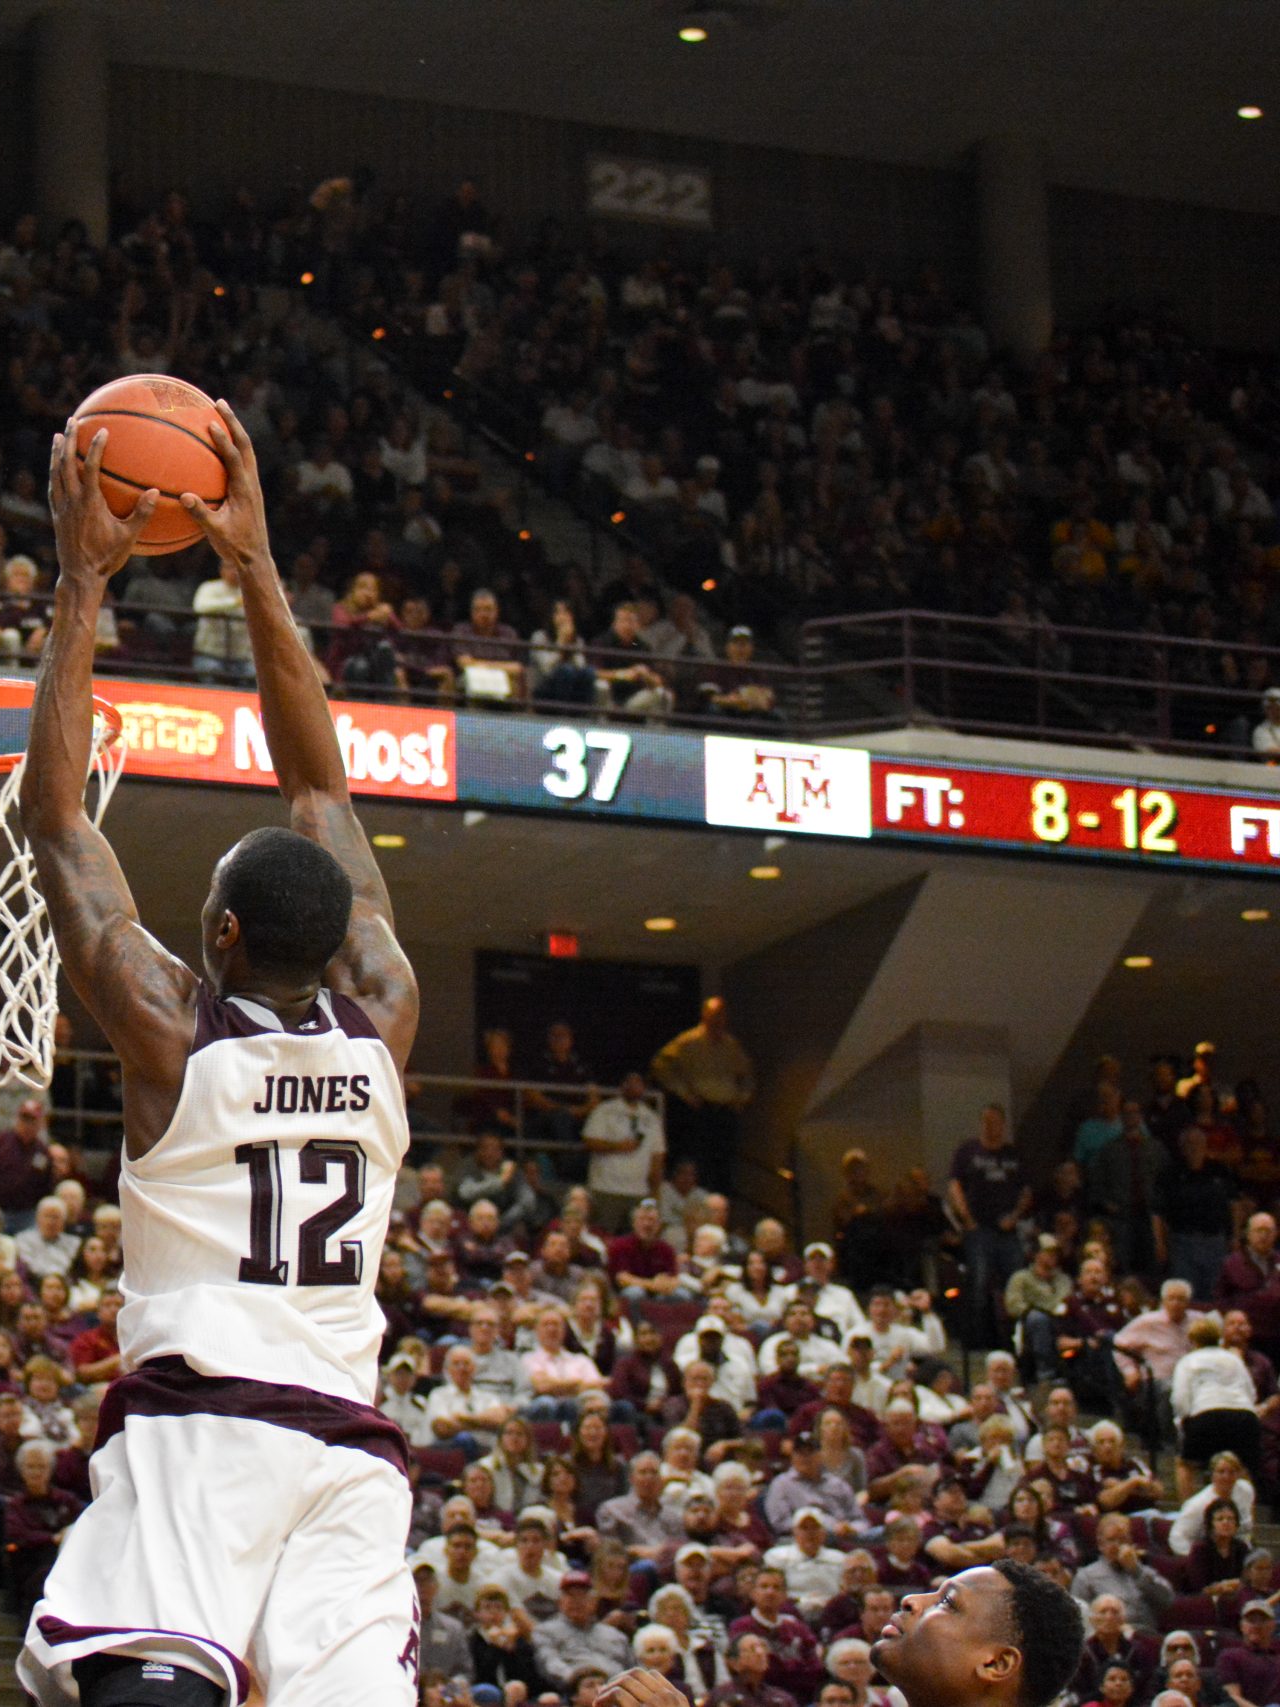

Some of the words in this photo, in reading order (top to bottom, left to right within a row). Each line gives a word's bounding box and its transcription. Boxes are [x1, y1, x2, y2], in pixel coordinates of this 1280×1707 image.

[589, 163, 711, 222] 222
[233, 706, 449, 787] Nhos!
[543, 727, 632, 802] 37
[885, 773, 965, 829] FT:
[253, 1074, 370, 1114] JONES
[234, 1139, 367, 1287] 12
